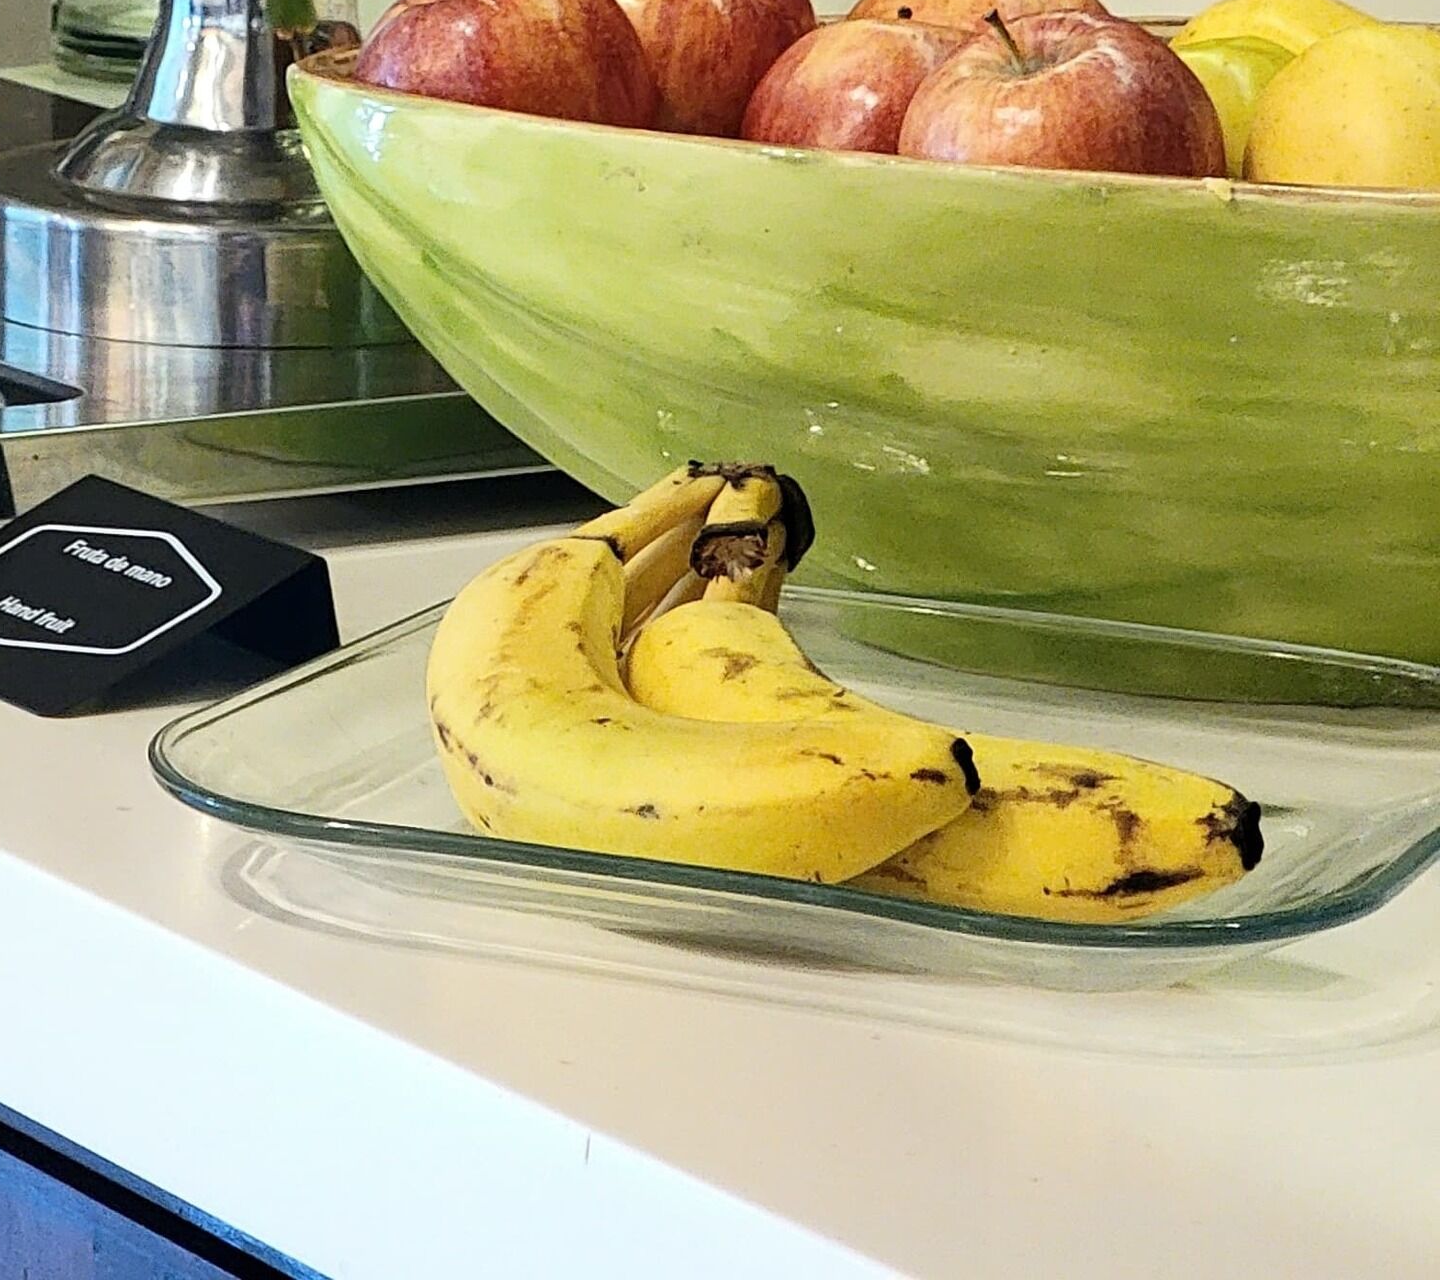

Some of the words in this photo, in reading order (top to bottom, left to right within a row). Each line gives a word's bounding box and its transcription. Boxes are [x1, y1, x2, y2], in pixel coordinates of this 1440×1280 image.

[63, 540, 106, 567] Fruta
[104, 554, 128, 572] de
[125, 565, 172, 588] mano
[35, 609, 76, 633] fruit
